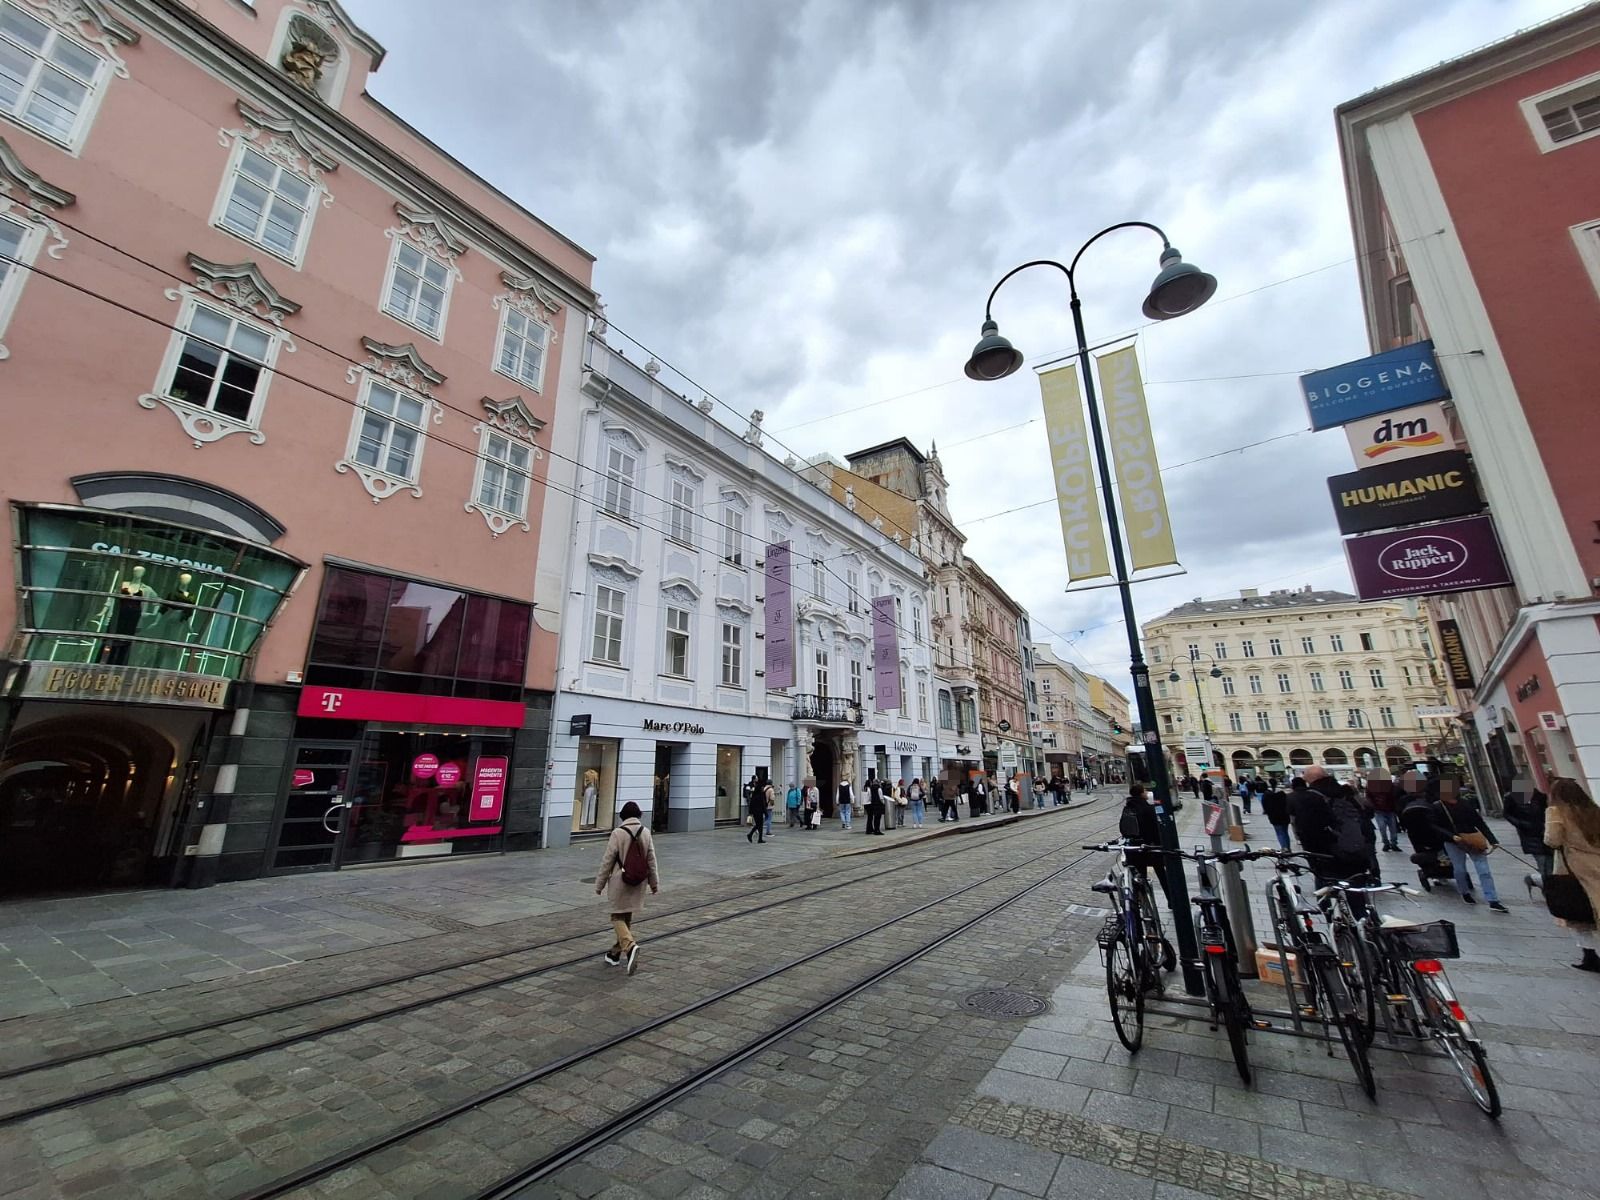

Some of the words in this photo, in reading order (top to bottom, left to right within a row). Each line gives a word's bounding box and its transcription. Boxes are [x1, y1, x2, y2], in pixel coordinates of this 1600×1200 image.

[1308, 361, 1433, 402] BIOGENA
[1373, 417, 1428, 444] dm
[1340, 470, 1465, 508] HUMANIC
[1391, 551, 1456, 570] Ripperl
[1403, 544, 1442, 561] Jack
[1442, 628, 1470, 680] HUMANIC
[642, 718, 672, 732] Marc
[673, 721, 705, 735] O'Polo
